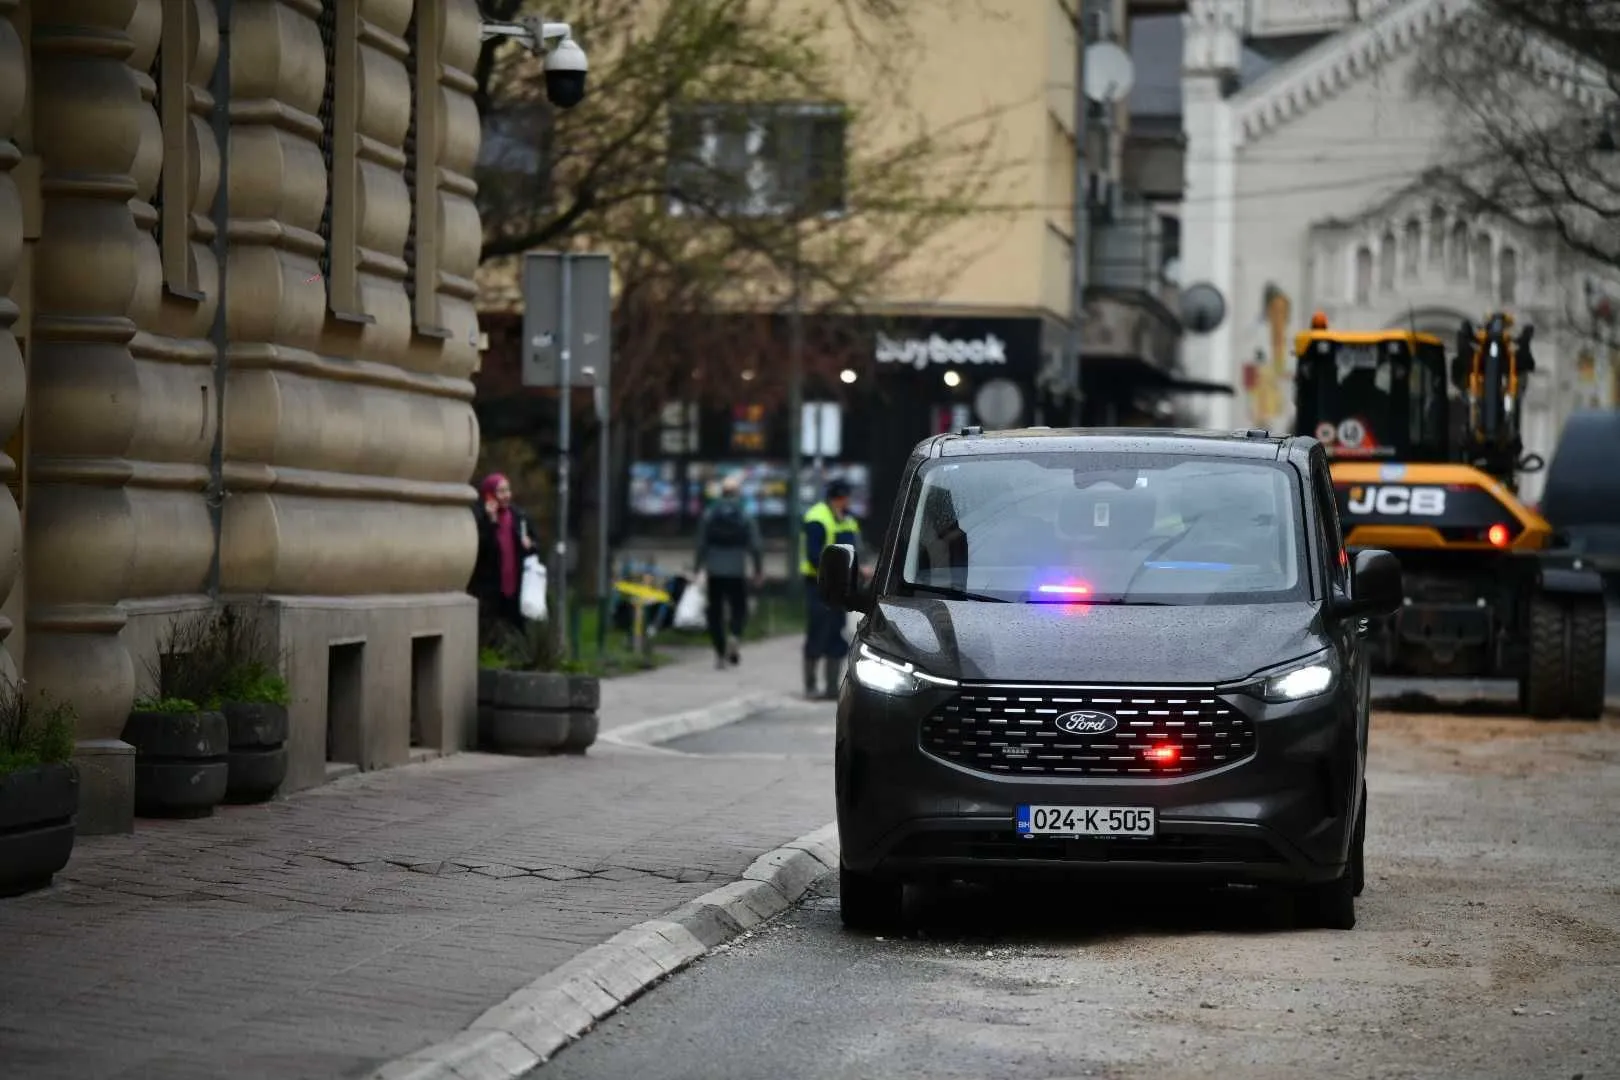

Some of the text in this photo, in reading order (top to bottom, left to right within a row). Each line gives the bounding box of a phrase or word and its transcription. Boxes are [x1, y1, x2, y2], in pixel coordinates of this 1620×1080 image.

[875, 332, 1006, 370] buybook
[1348, 486, 1446, 516] JCB
[1065, 713, 1106, 730] Ford
[1034, 808, 1151, 831] 024-K-505
